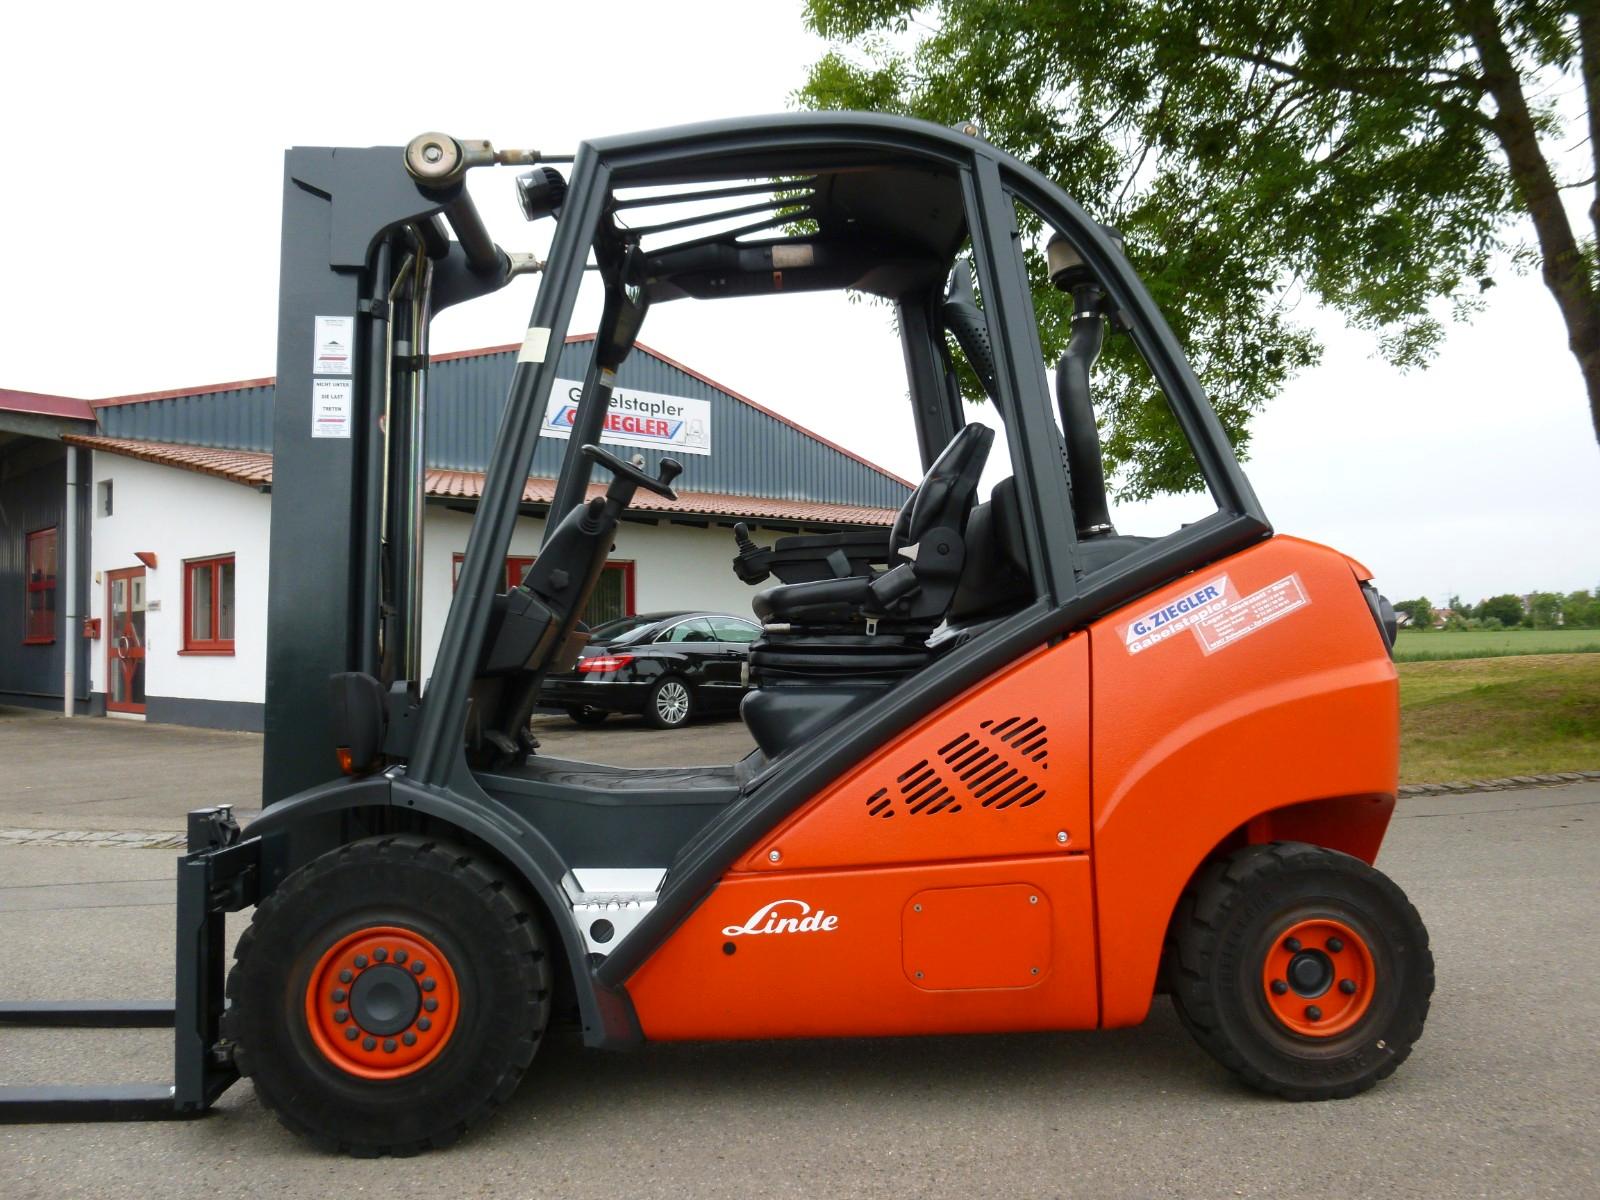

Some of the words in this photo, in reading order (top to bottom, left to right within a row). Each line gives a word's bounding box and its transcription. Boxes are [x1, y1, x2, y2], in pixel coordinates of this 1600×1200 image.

[568, 387, 684, 416] Gelstapler
[1128, 597, 1229, 654] Gabelstapler
[1132, 621, 1152, 636] G.
[1149, 585, 1220, 628] ZIEGLER
[721, 899, 839, 937] Linde
